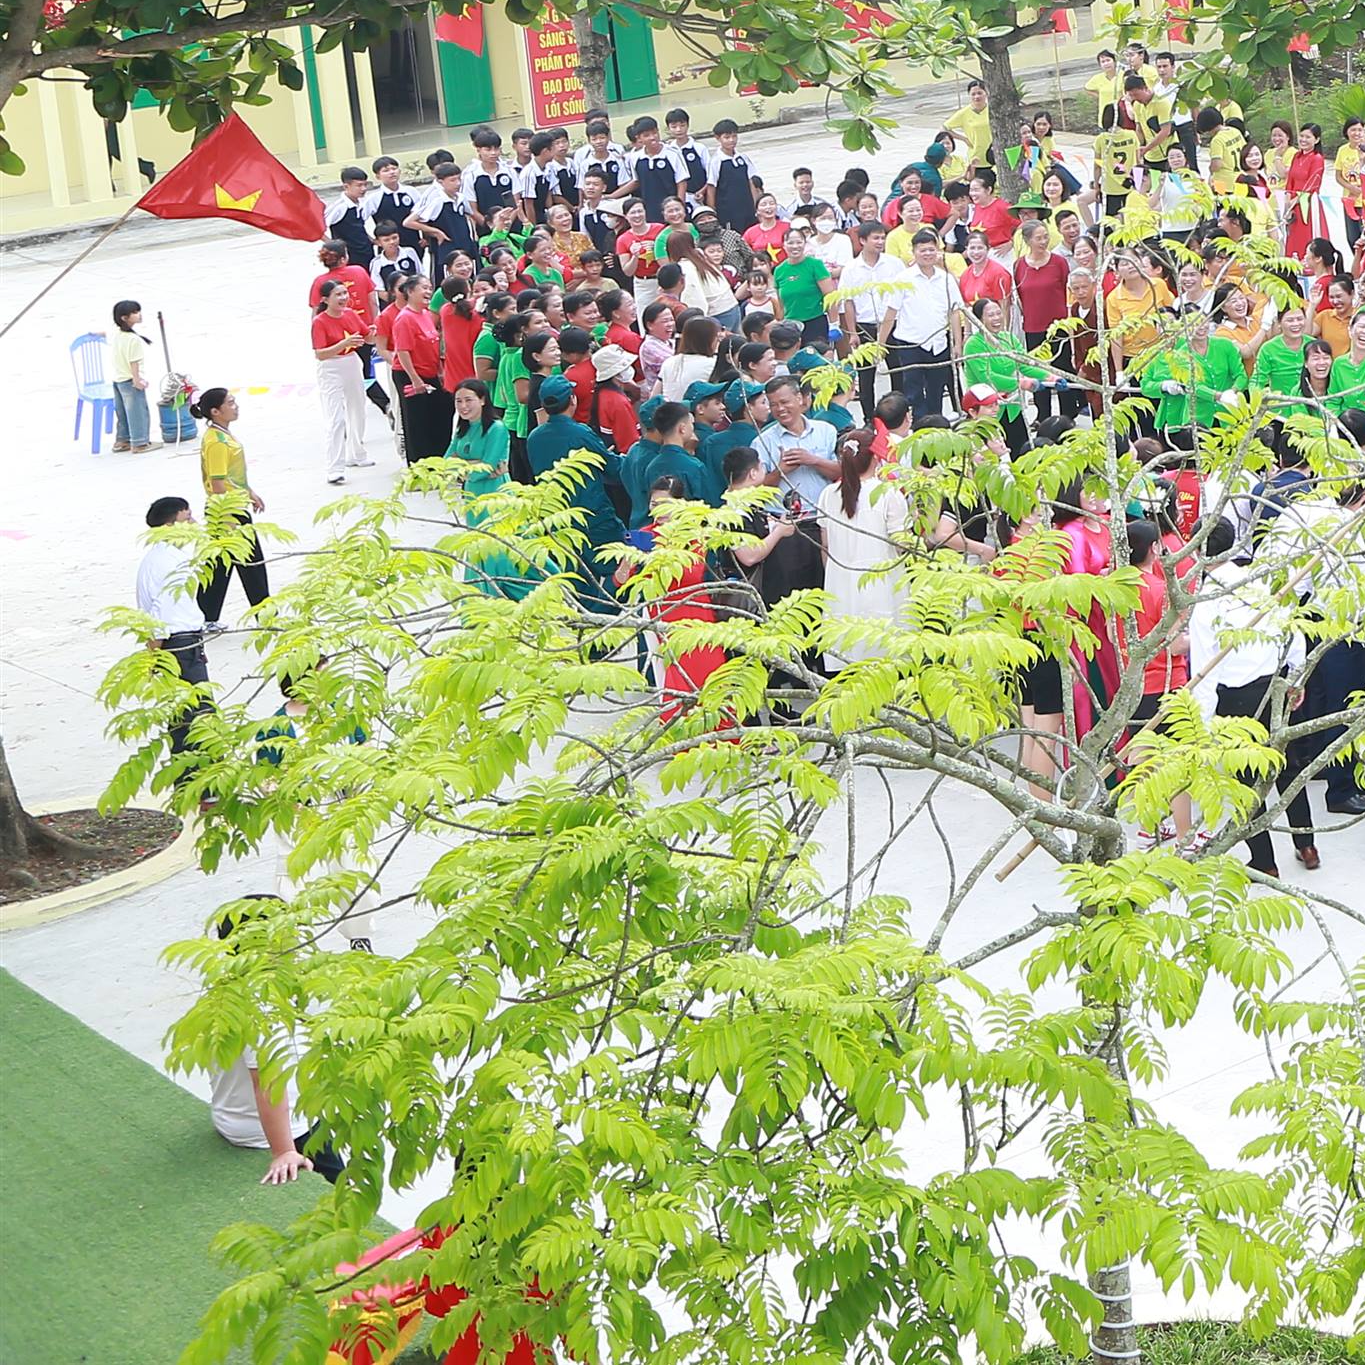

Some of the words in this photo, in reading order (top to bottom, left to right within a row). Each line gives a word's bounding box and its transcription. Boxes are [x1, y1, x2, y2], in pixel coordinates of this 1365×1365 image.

[539, 29, 566, 49] SÁNG
[534, 50, 563, 73] PHẨM
[542, 78, 562, 98] ĐẠO
[545, 97, 561, 119] LỐI
